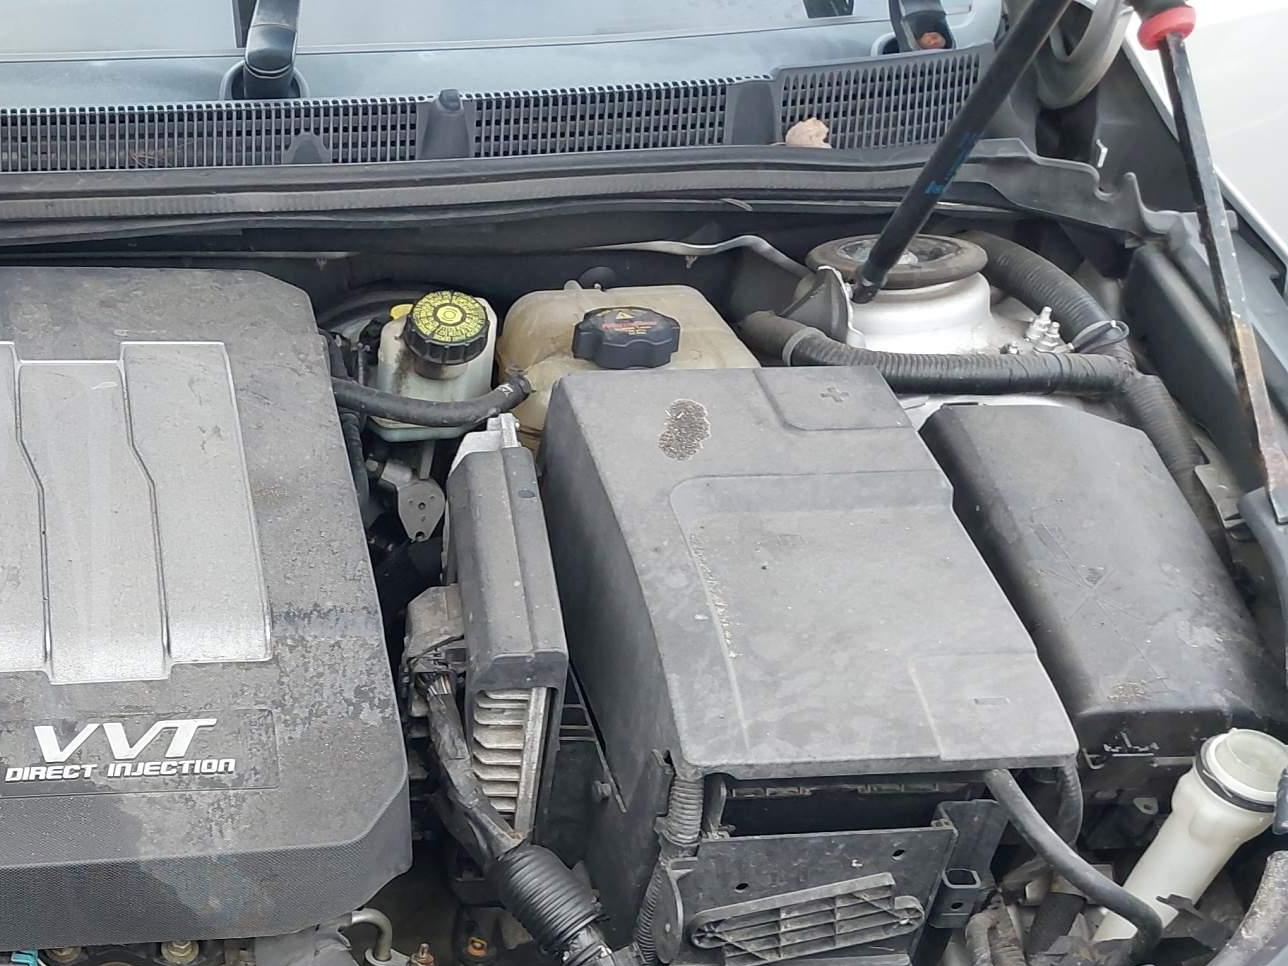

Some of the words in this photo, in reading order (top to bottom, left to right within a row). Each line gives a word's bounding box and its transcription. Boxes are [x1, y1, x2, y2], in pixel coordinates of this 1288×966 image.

[33, 718, 218, 763] VVT
[5, 763, 98, 783] DIRECT
[107, 758, 236, 778] INJECTION
